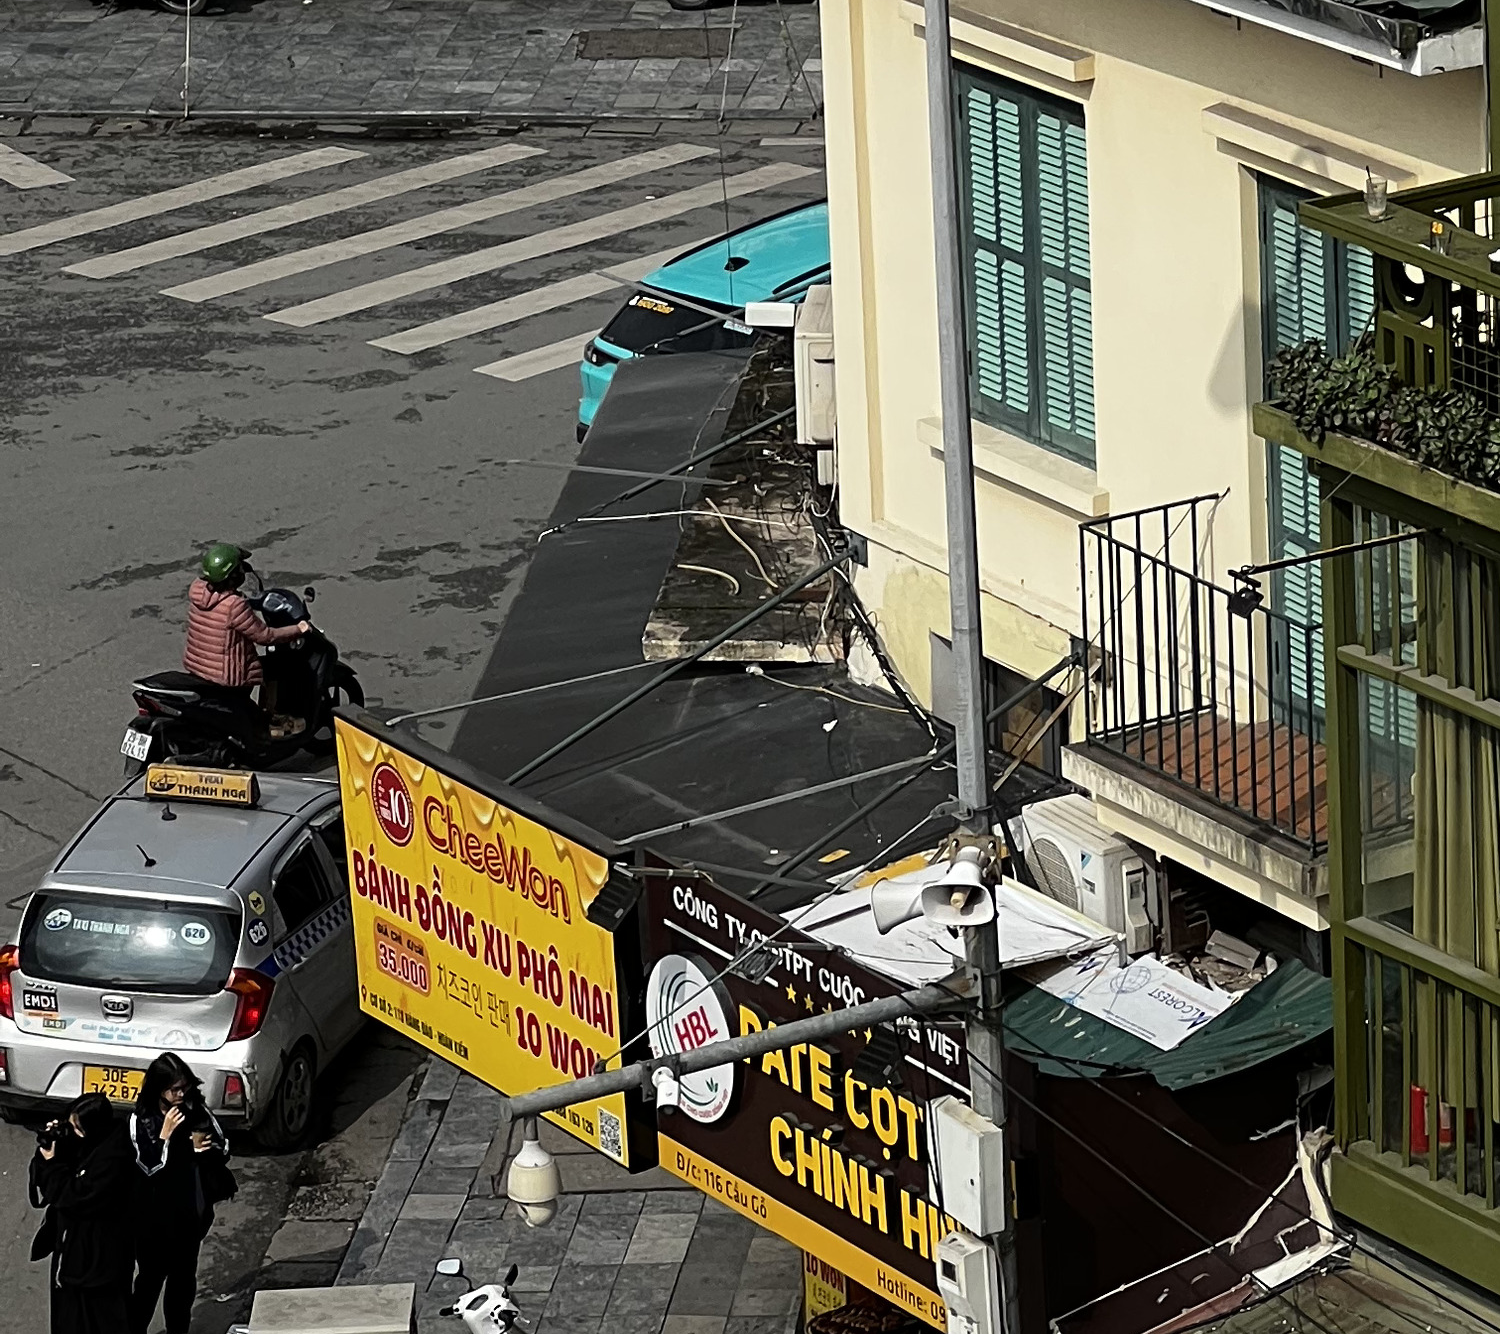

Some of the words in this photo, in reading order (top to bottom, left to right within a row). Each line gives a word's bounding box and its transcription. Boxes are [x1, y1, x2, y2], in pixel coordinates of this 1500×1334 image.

[177, 784, 217, 796] THANH
[222, 788, 246, 799] NGA
[424, 796, 571, 924] CheeWon
[249, 922, 268, 944] 626
[353, 843, 412, 923] BÁNH
[415, 865, 477, 958] ĐỒNG
[481, 920, 512, 978] XU
[516, 945, 563, 1007] PHÔ
[569, 970, 614, 1038] MAI
[379, 944, 427, 991] 35.000
[673, 886, 719, 930] CÔNG
[724, 913, 747, 944] TY
[927, 1028, 962, 1066] VIỆT
[515, 1007, 542, 1057] 10
[675, 1005, 719, 1053] HBL
[102, 1069, 129, 1084] 30E
[676, 1151, 702, 1181] Đ/c:
[703, 1168, 723, 1195] 116
[770, 1116, 888, 1234] CHÍNH
[877, 1268, 928, 1314] Hotline:
